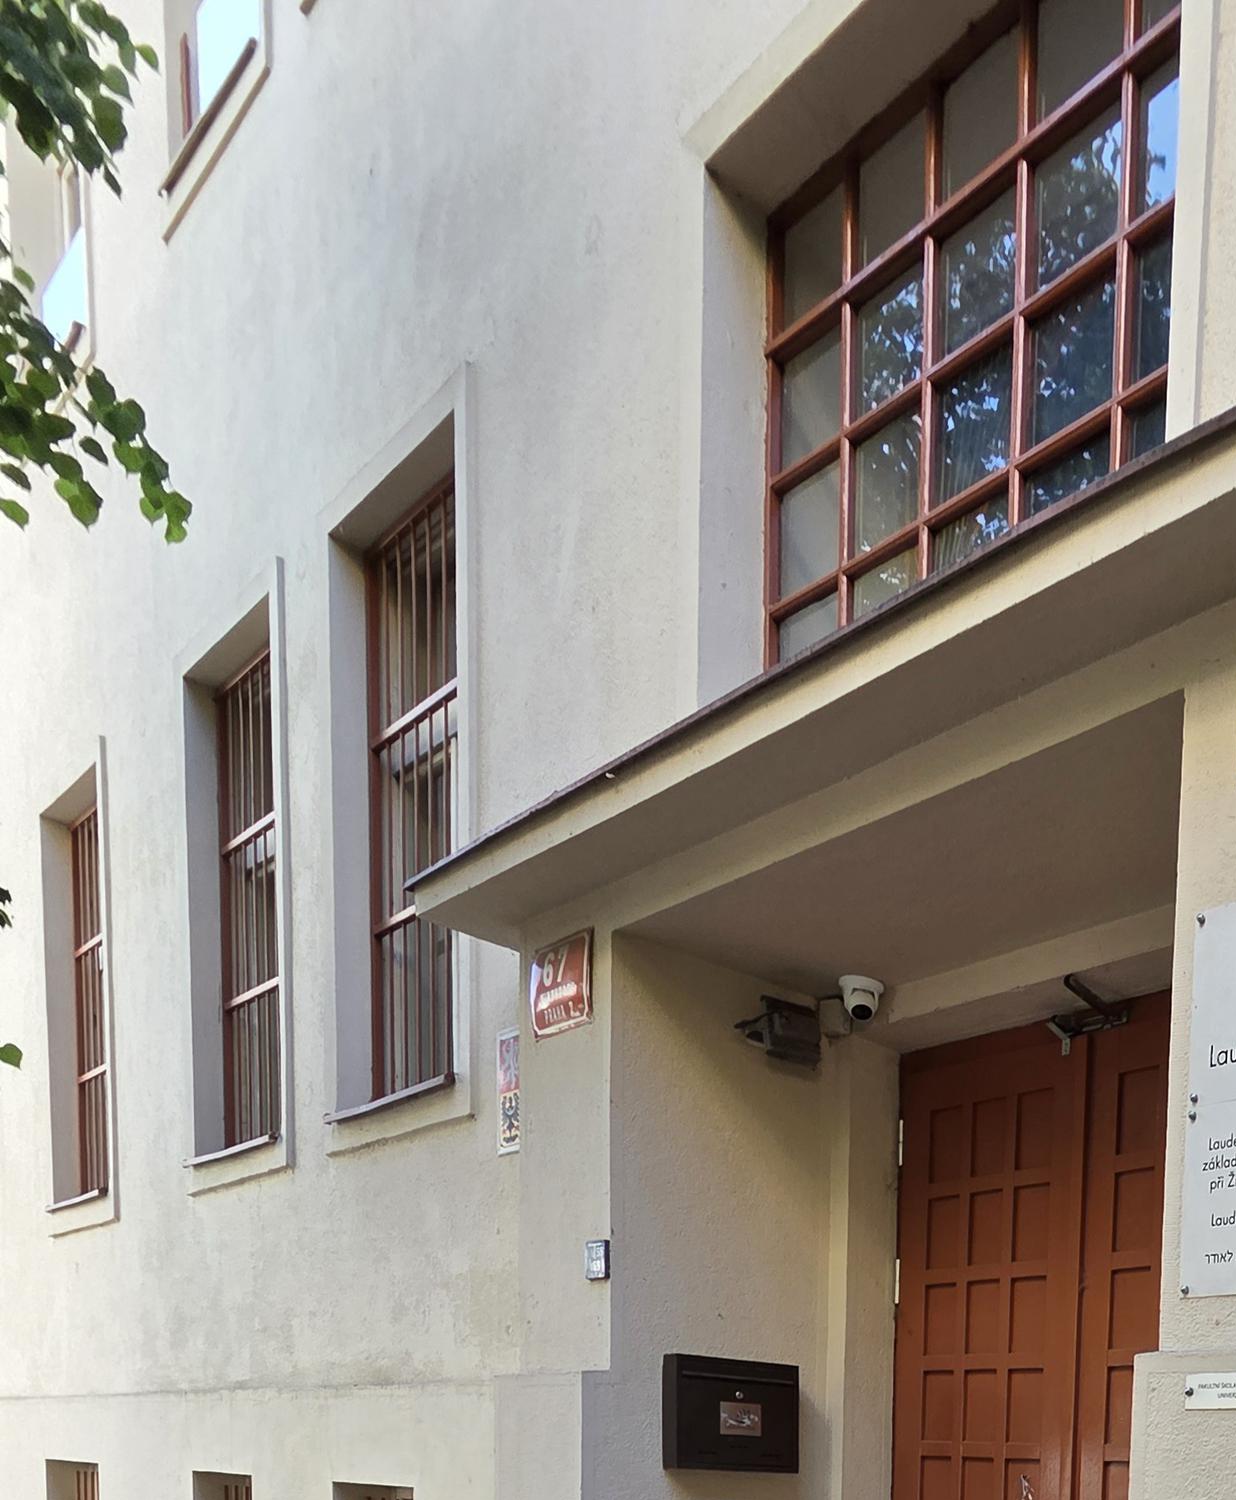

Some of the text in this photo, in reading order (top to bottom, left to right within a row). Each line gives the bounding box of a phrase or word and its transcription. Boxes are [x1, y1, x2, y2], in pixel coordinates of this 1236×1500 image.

[542, 944, 571, 987] 67
[1209, 1175, 1225, 1194] při
[1204, 1250, 1234, 1264] לאודר
